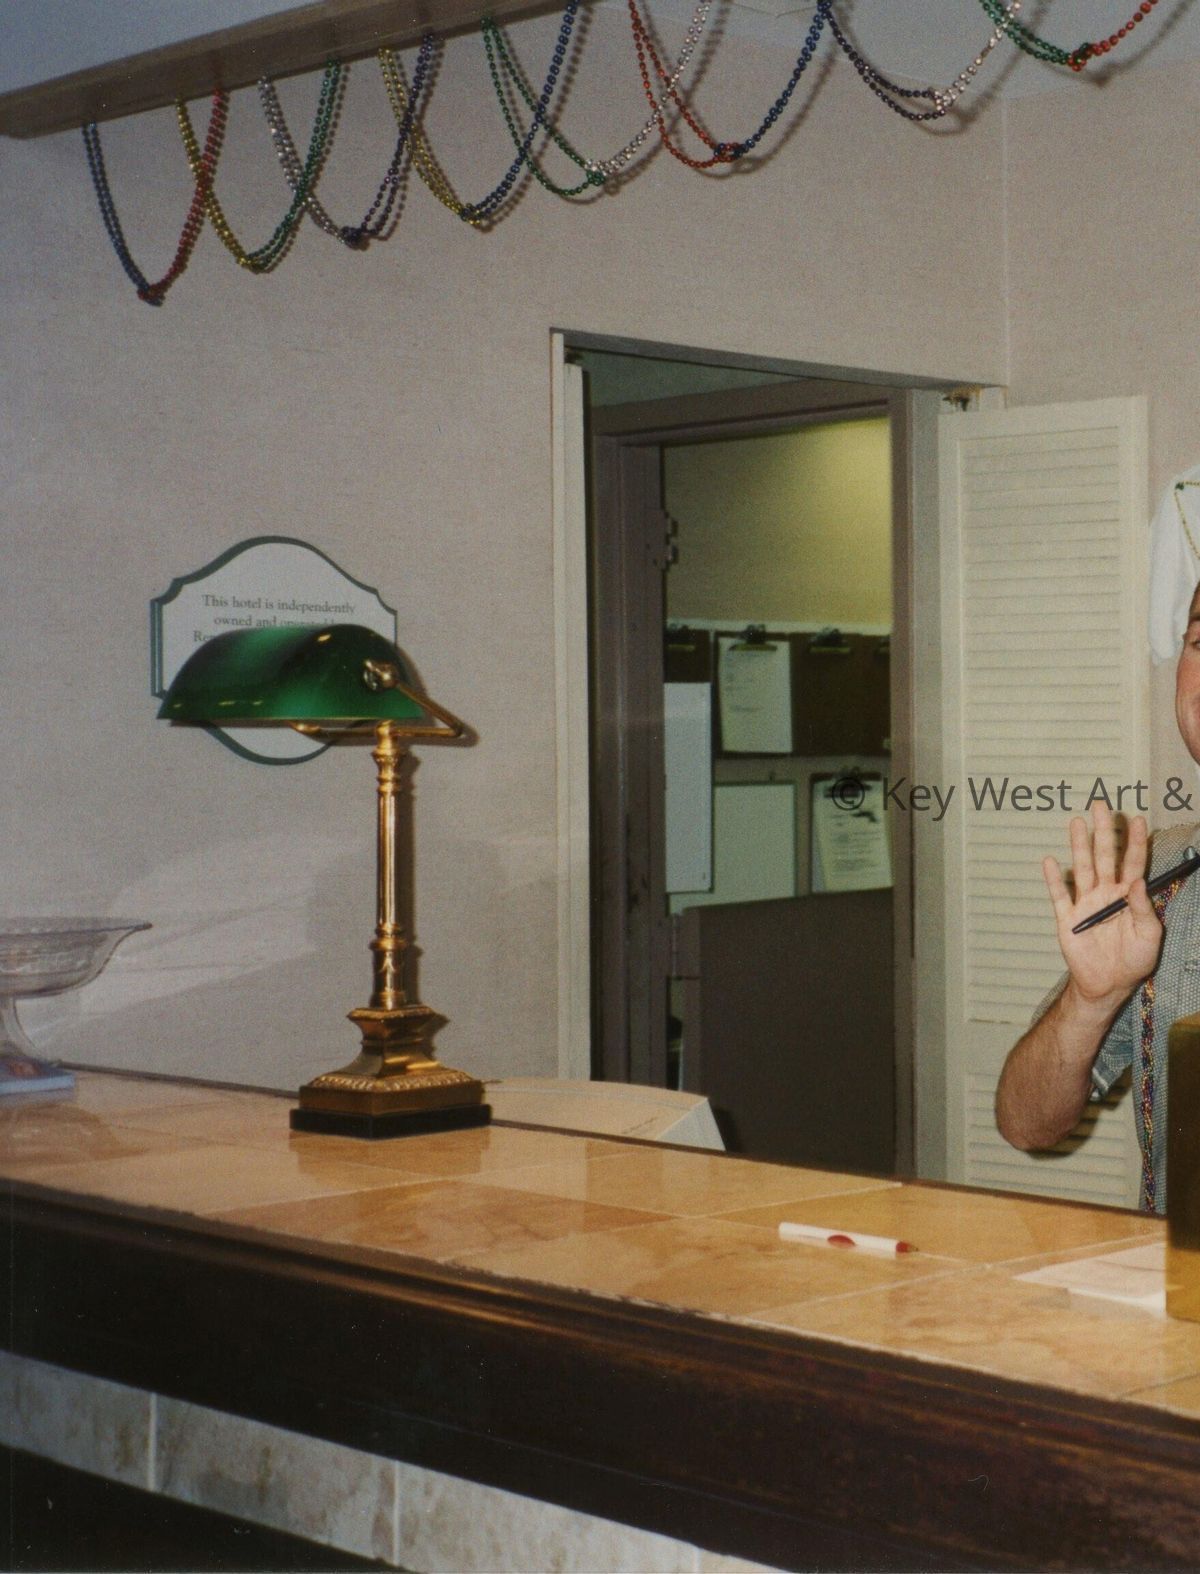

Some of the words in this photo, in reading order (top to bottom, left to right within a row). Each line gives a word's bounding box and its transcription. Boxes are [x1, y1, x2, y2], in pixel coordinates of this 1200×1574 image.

[201, 594, 229, 607] This
[232, 597, 262, 609] hotel
[265, 599, 274, 610] is
[277, 600, 356, 614] independently
[213, 615, 252, 627] owned
[255, 616, 277, 628] and
